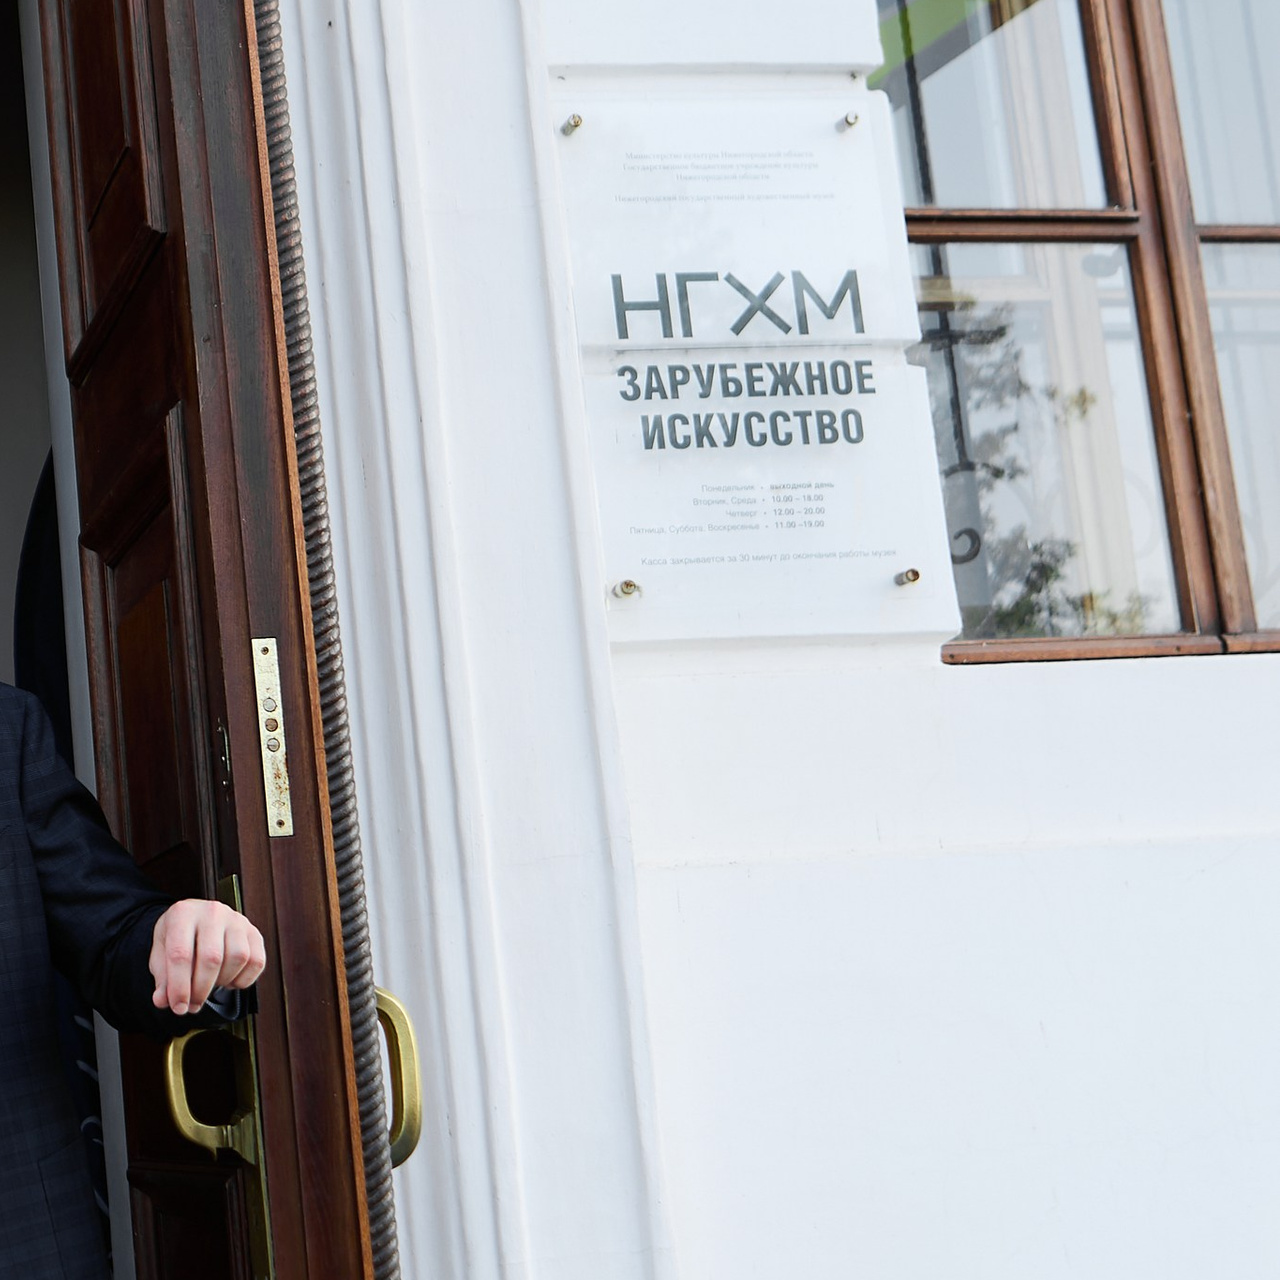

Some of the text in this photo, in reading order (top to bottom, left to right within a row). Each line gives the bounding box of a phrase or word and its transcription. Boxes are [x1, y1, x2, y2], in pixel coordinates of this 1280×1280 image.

[610, 268, 866, 340] НГХМ
[618, 360, 876, 402] ЗАРУБЕЖНОЕ
[640, 409, 865, 450] ИСКУССТВО
[772, 495, 793, 503] 10.00
[773, 508, 795, 516] 12.00
[803, 507, 825, 515] 20.00
[774, 521, 796, 529] 11.00
[641, 557, 667, 566] Касса
[738, 554, 750, 562] 30
